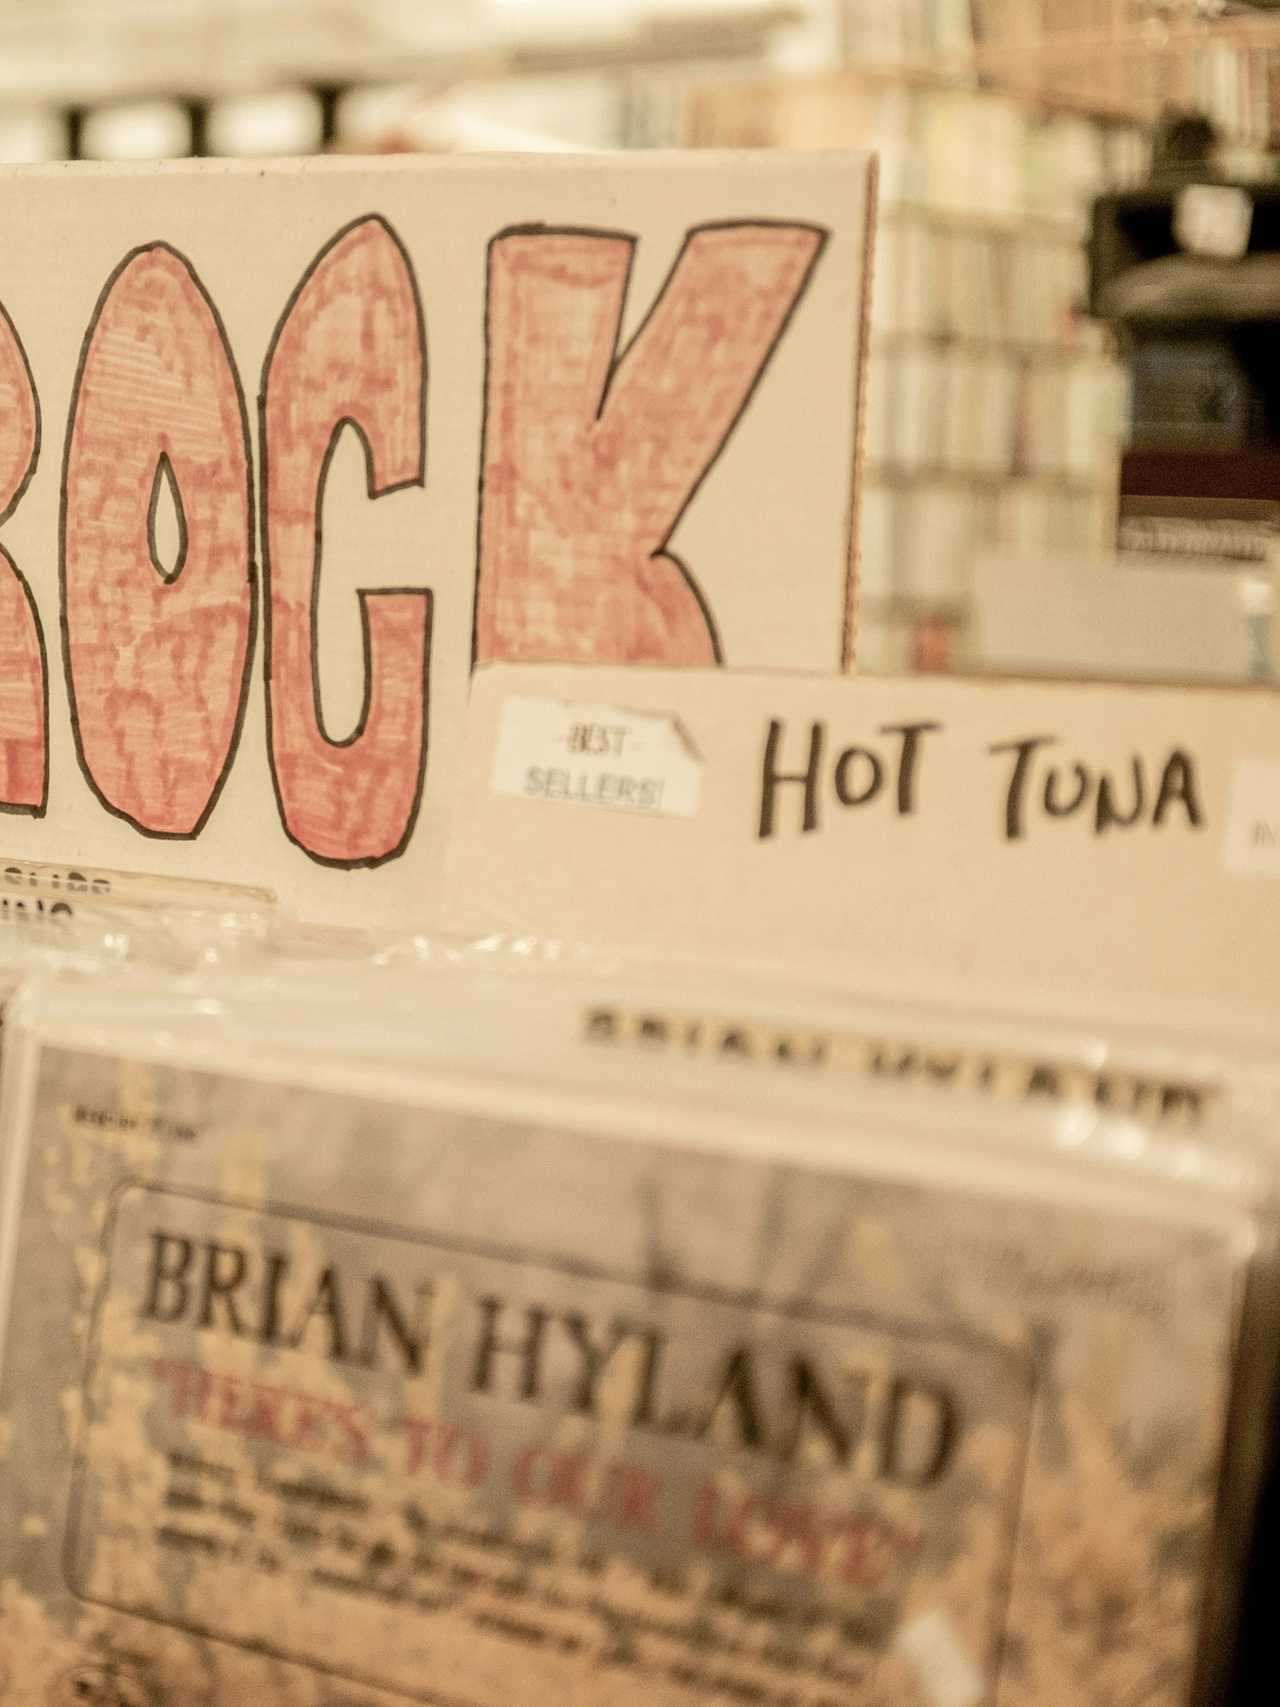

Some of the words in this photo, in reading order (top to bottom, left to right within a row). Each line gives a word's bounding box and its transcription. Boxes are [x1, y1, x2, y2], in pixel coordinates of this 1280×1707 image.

[756, 718, 941, 839] HOT
[989, 735, 1207, 839] TUNA
[138, 1227, 437, 1382] BRIAN
[468, 1290, 968, 1488] HYLAND
